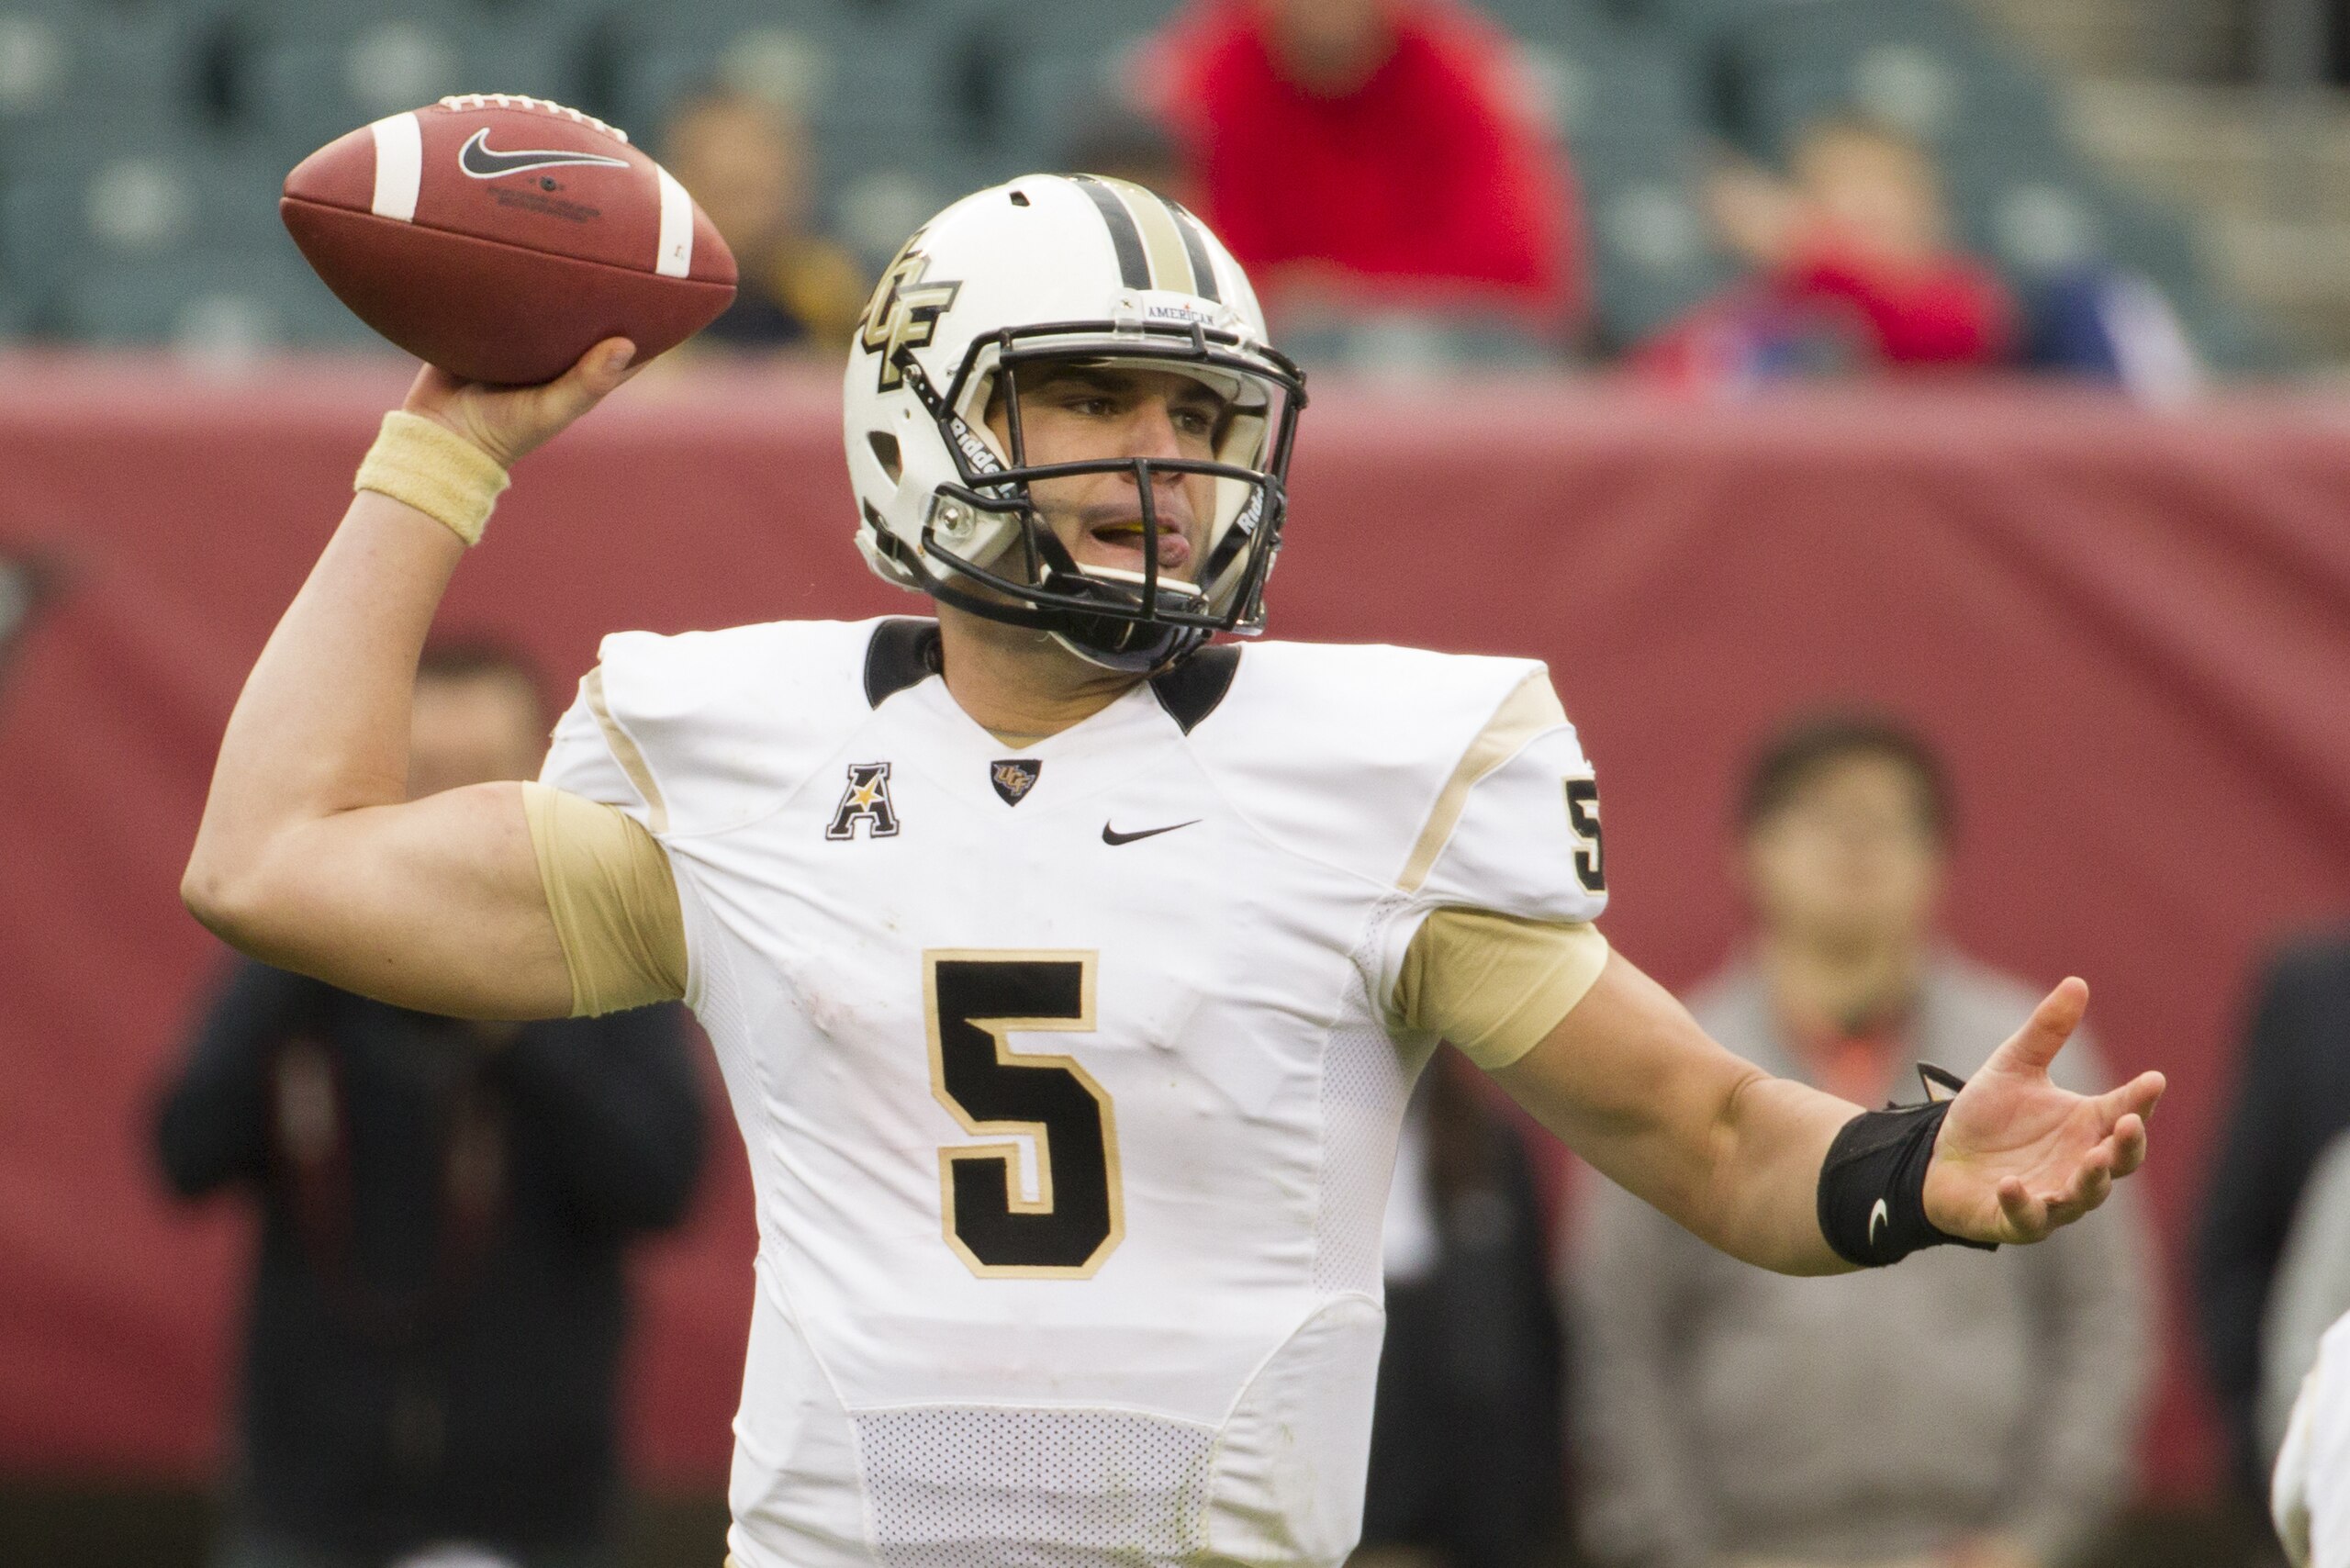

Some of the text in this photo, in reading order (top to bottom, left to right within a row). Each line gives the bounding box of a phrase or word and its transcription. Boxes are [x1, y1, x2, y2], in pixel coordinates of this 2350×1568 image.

[1148, 306, 1214, 326] AMERICAN
[950, 417, 1016, 499] Riddel
[993, 763, 1036, 797] UCF
[1561, 775, 1608, 896] 5
[923, 948, 1126, 1280] 5
